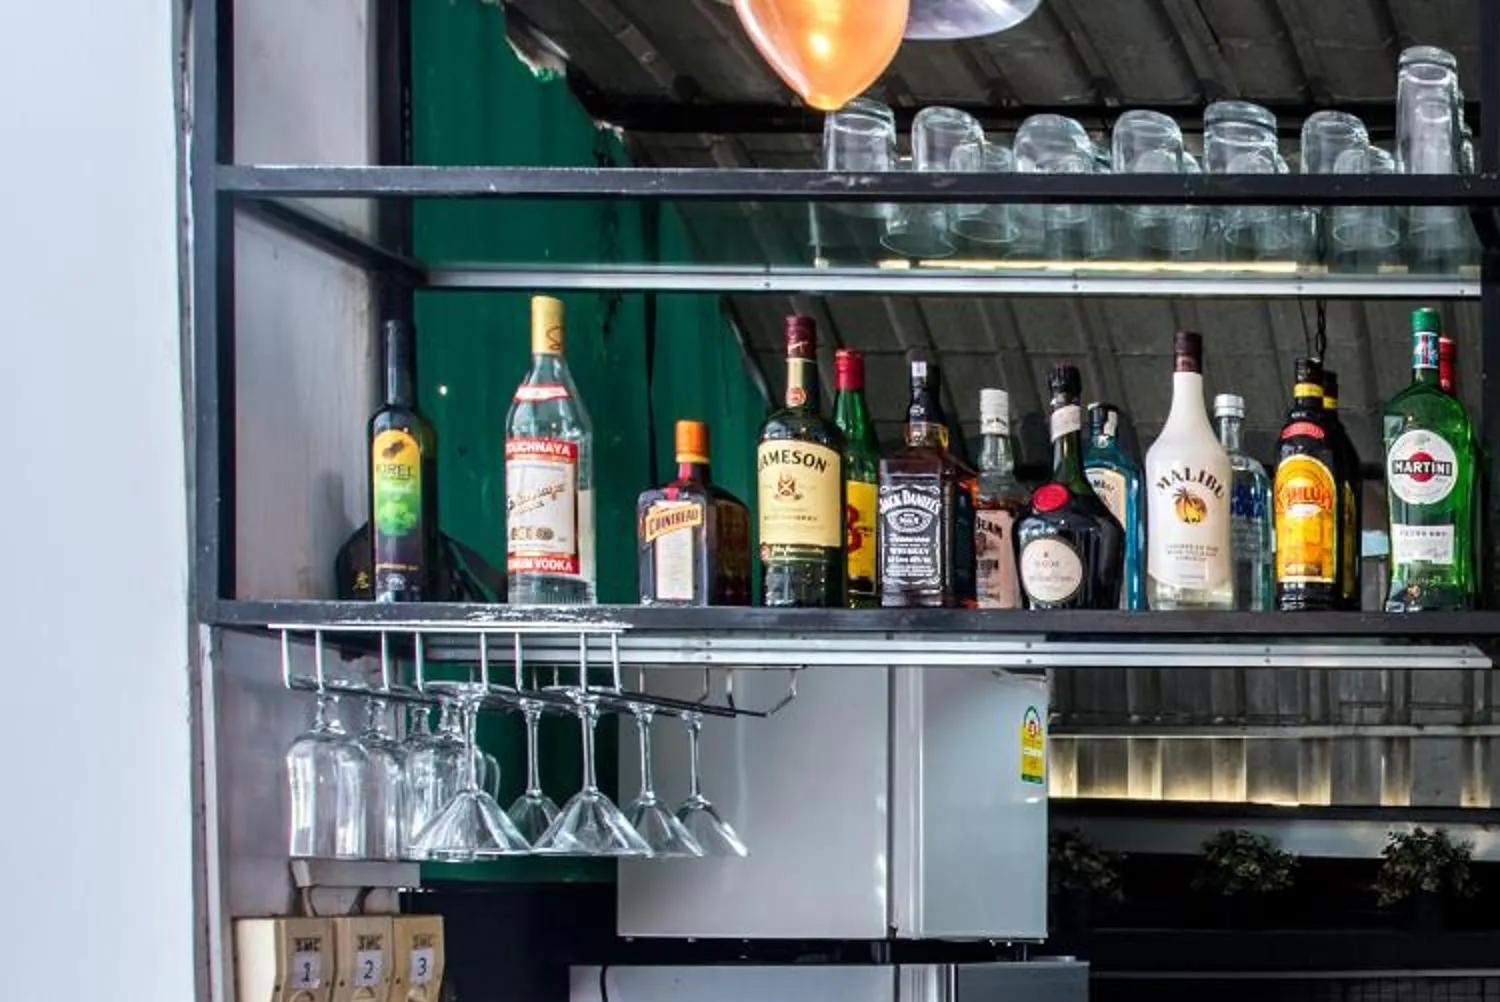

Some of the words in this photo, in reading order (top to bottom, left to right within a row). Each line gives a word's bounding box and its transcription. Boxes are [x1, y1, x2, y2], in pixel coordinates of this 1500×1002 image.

[1395, 460, 1451, 477] MARTINI
[1156, 467, 1225, 499] MALIBU
[649, 508, 699, 536] COINTREAU
[301, 961, 311, 982] 1
[363, 960, 374, 980] 2
[417, 956, 428, 977] 3
